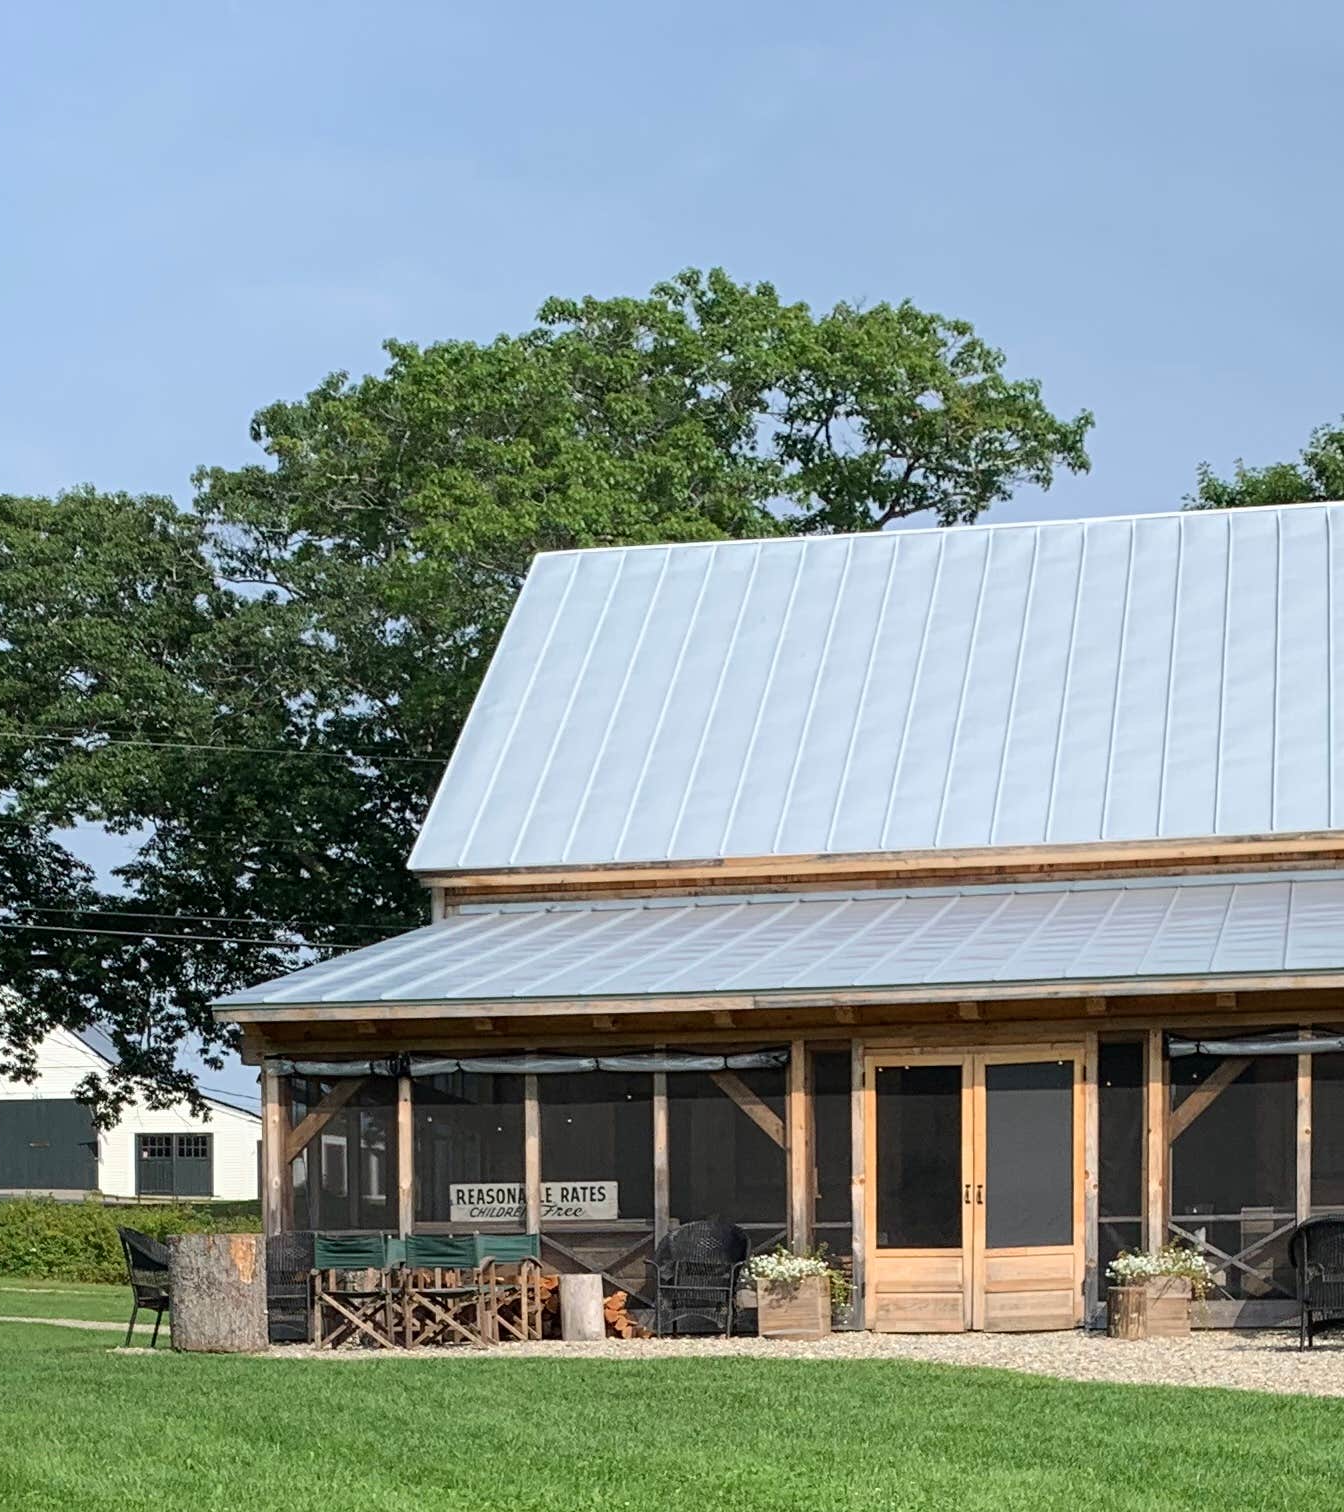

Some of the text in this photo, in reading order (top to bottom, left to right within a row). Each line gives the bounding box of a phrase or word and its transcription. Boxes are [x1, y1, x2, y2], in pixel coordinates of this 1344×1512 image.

[456, 1186, 606, 1205] REASONAE RATES
[540, 1204, 584, 1217] Free
